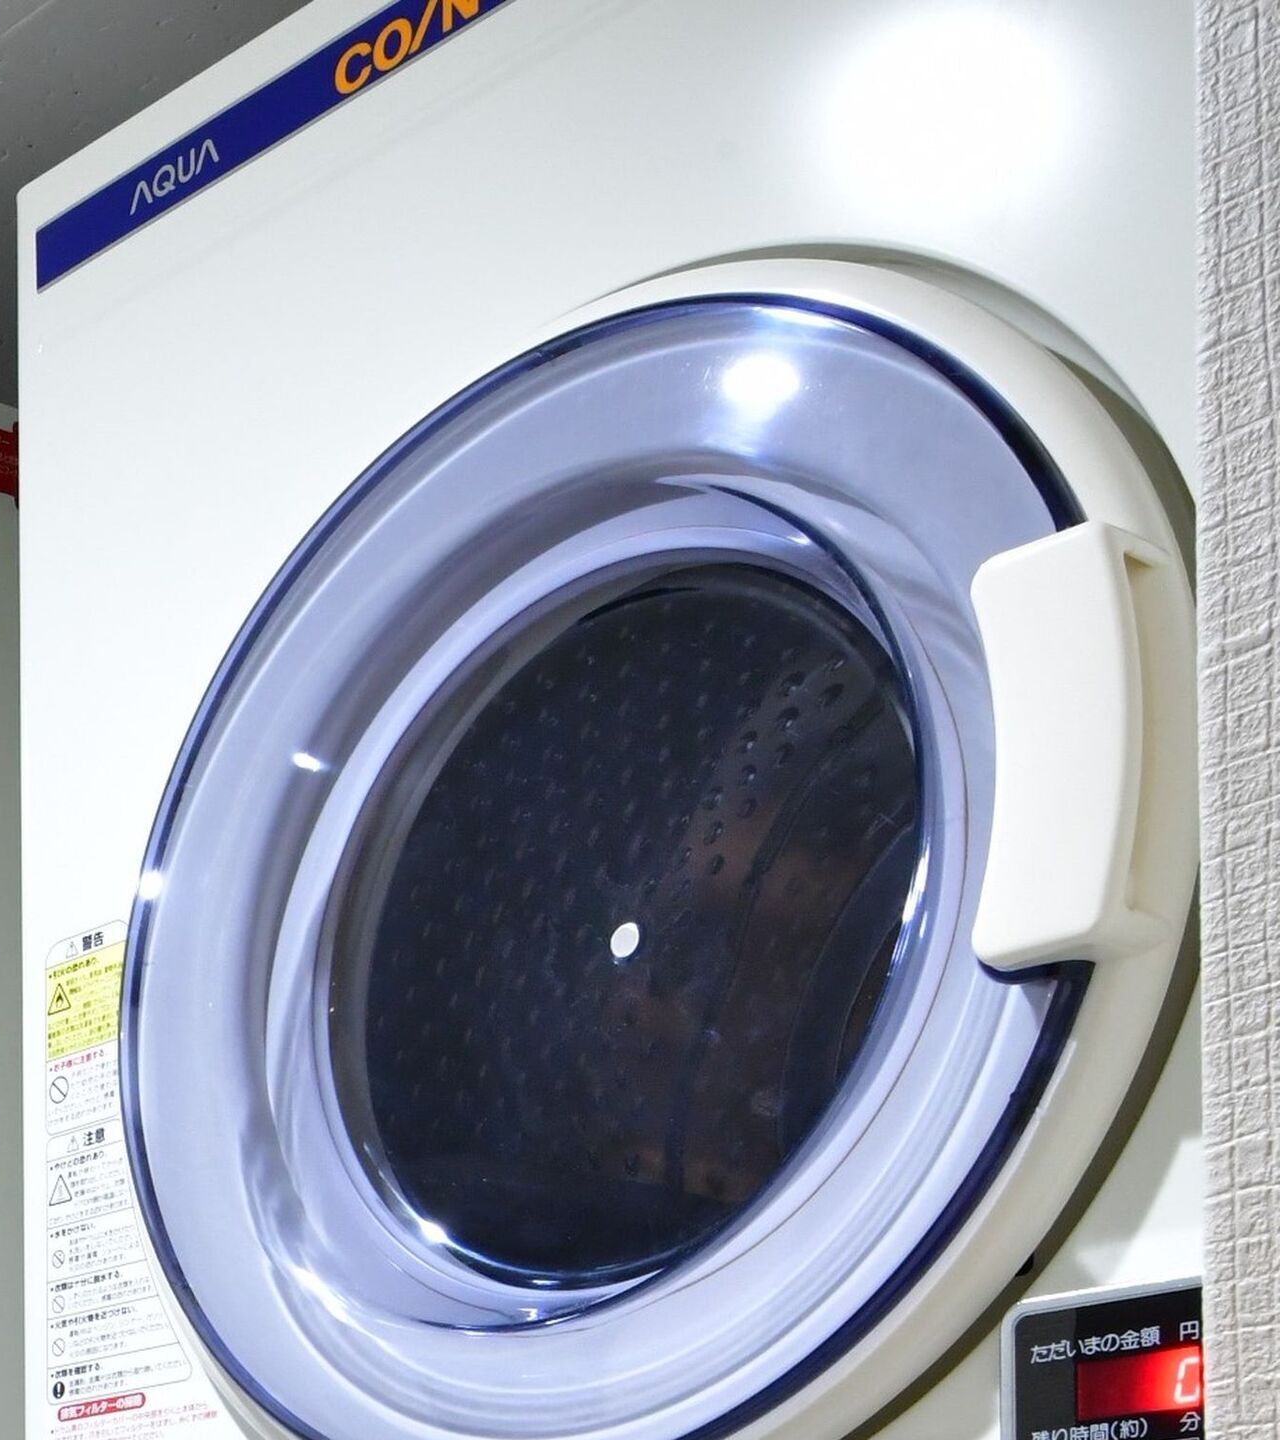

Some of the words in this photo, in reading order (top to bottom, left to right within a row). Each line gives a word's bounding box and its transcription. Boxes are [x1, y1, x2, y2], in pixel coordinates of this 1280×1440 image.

[129, 138, 220, 215] AQUA
[82, 931, 104, 951] 警告
[82, 1127, 105, 1146] 注意
[1030, 1325, 1161, 1364] ただいまの金額
[1179, 1320, 1200, 1341] 円
[1179, 1411, 1201, 1433] 分
